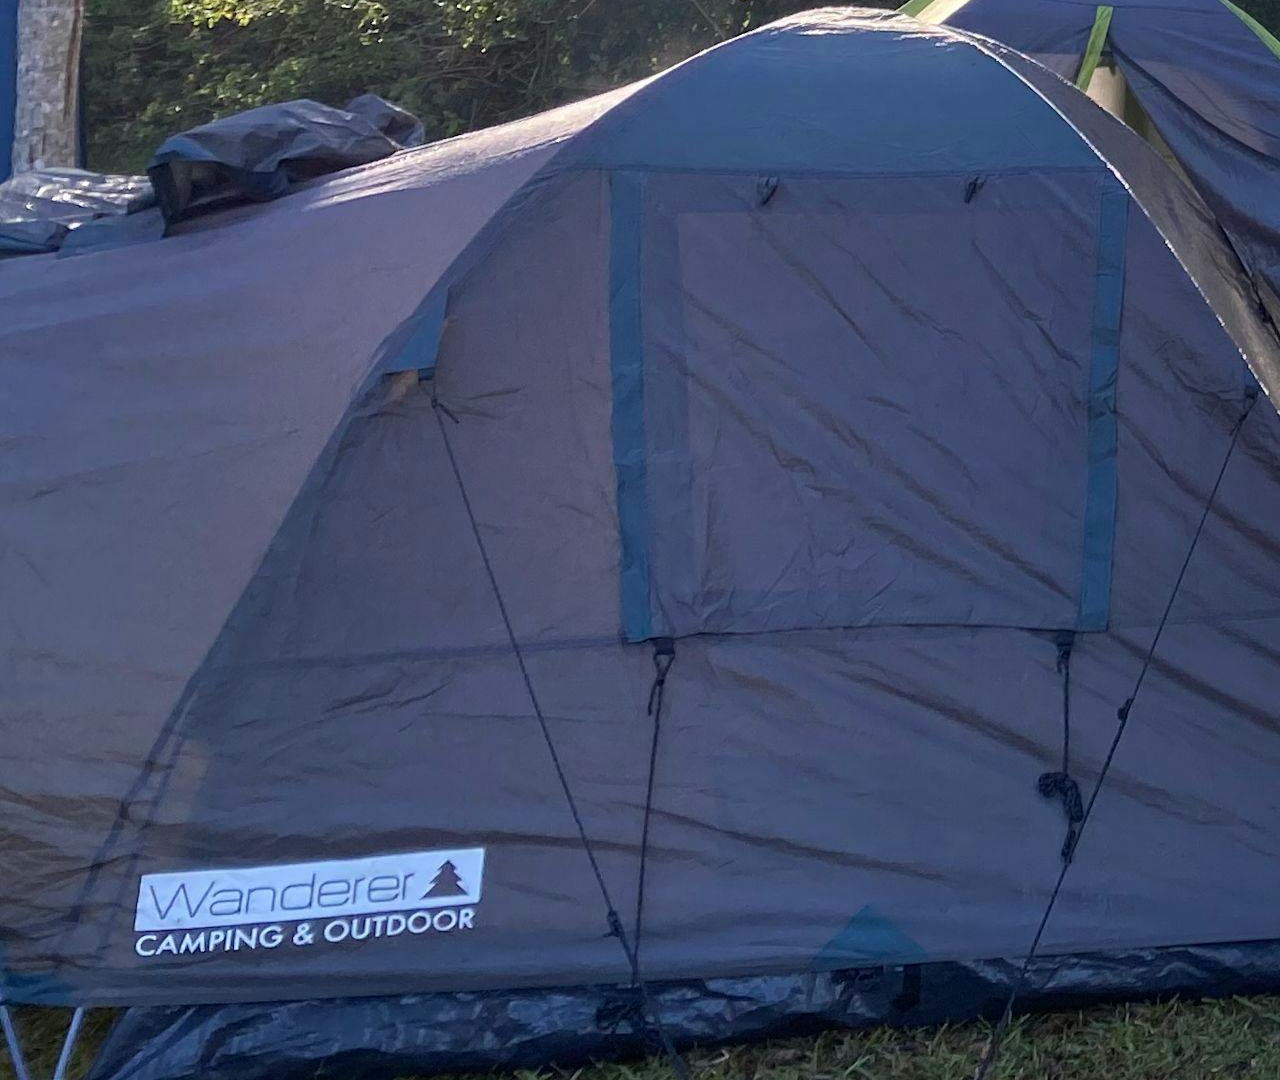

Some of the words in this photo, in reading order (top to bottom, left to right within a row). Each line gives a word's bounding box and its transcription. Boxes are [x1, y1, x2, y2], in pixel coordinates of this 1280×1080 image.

[149, 873, 415, 920] Wanderer
[135, 926, 283, 957] CAMPING
[292, 923, 314, 946] &
[324, 908, 475, 941] OUTDOOR
